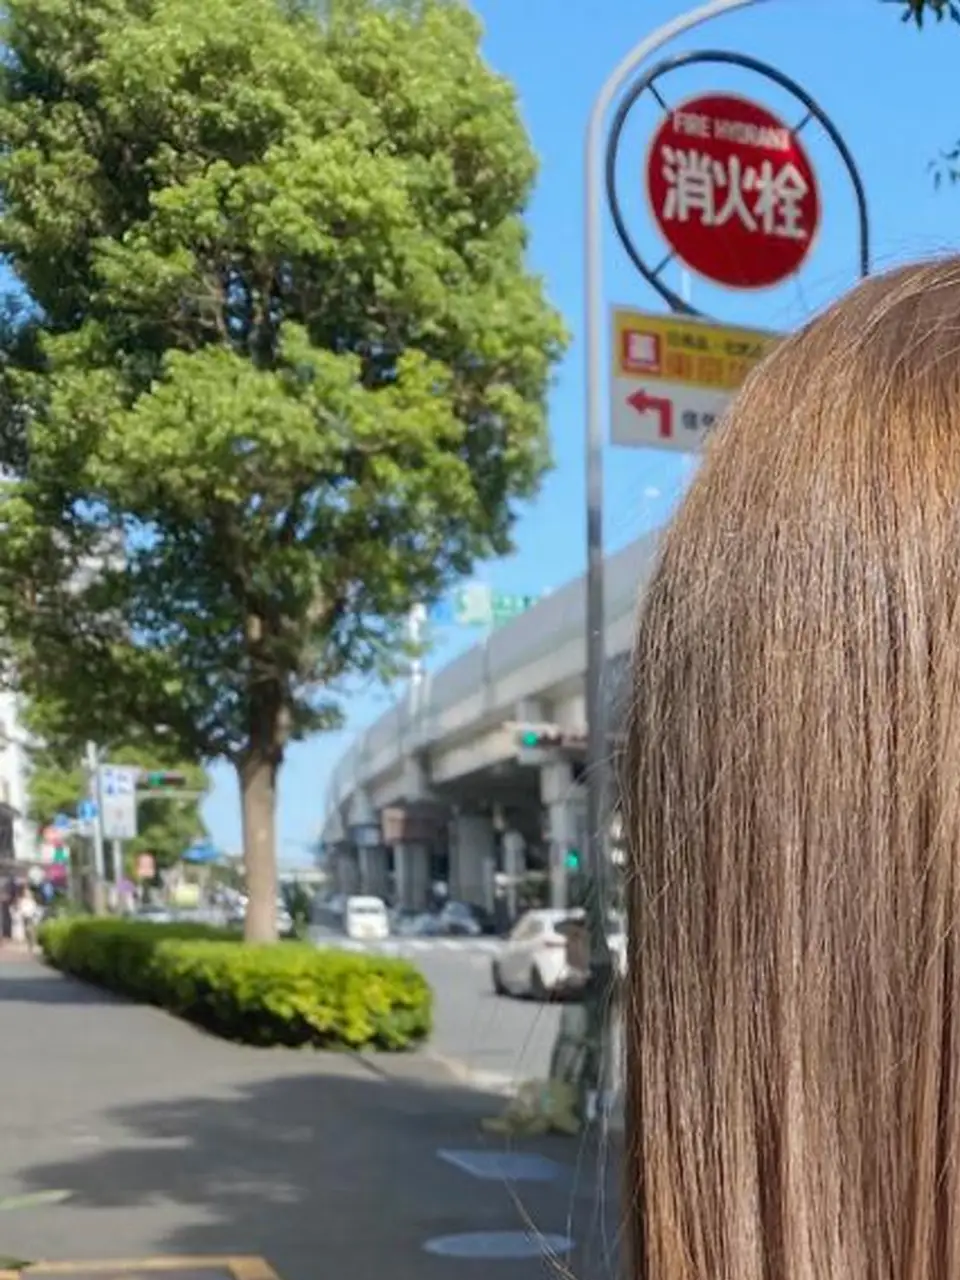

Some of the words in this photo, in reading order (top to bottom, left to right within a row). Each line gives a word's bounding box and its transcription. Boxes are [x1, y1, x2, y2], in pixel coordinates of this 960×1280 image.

[673, 112, 711, 138] FIRE
[661, 144, 808, 239] 消火栓
